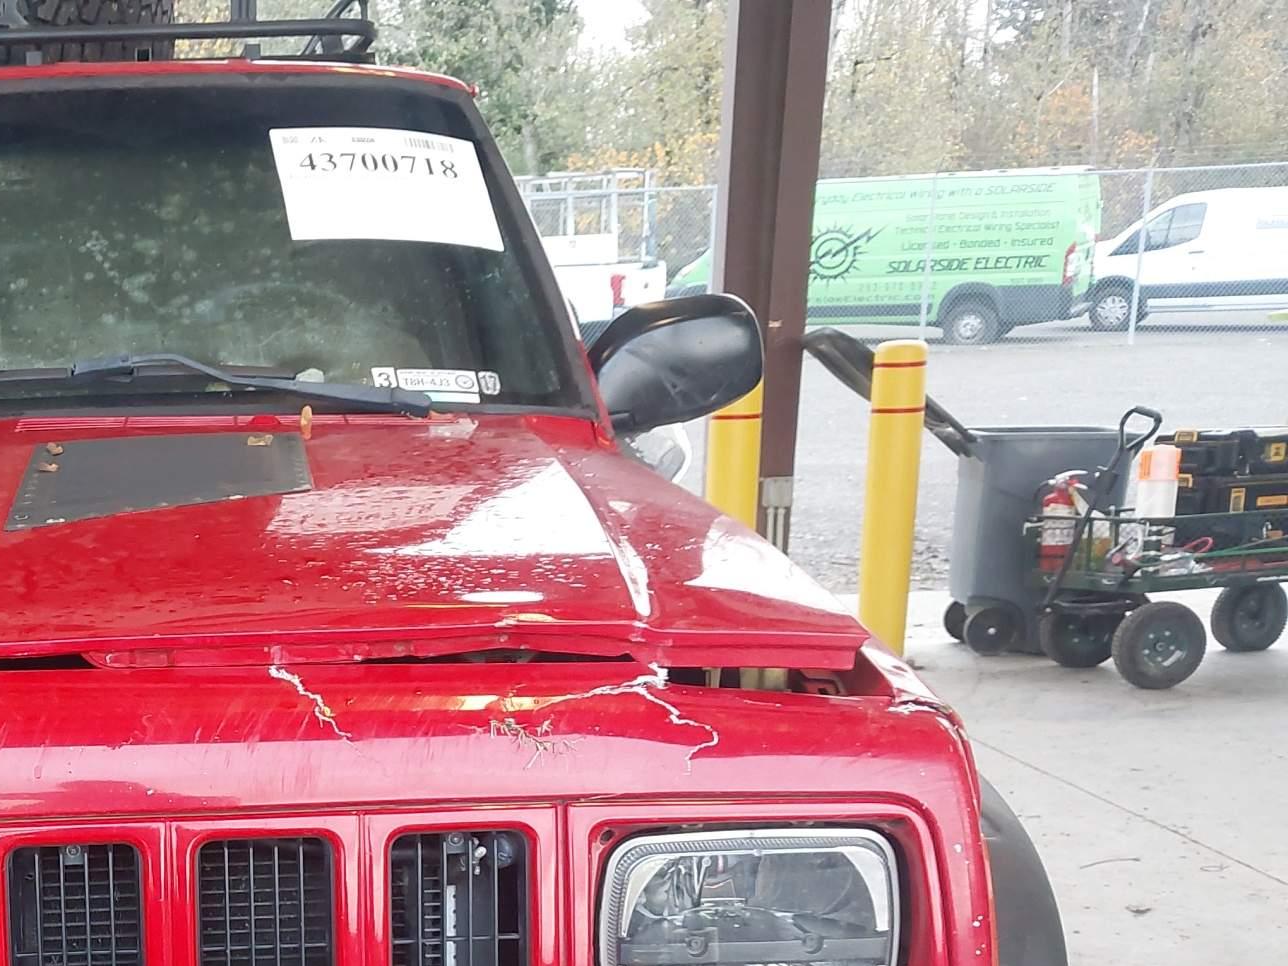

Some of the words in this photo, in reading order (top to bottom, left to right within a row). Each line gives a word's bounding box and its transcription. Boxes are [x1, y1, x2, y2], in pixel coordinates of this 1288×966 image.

[298, 152, 458, 180] 43700718
[985, 182, 1056, 196] SOLARSIDE
[960, 239, 1001, 249] Bonded
[1011, 236, 1054, 247] Insured
[886, 258, 972, 273] SOLARSIDE
[974, 254, 1051, 269] ELECTRIC
